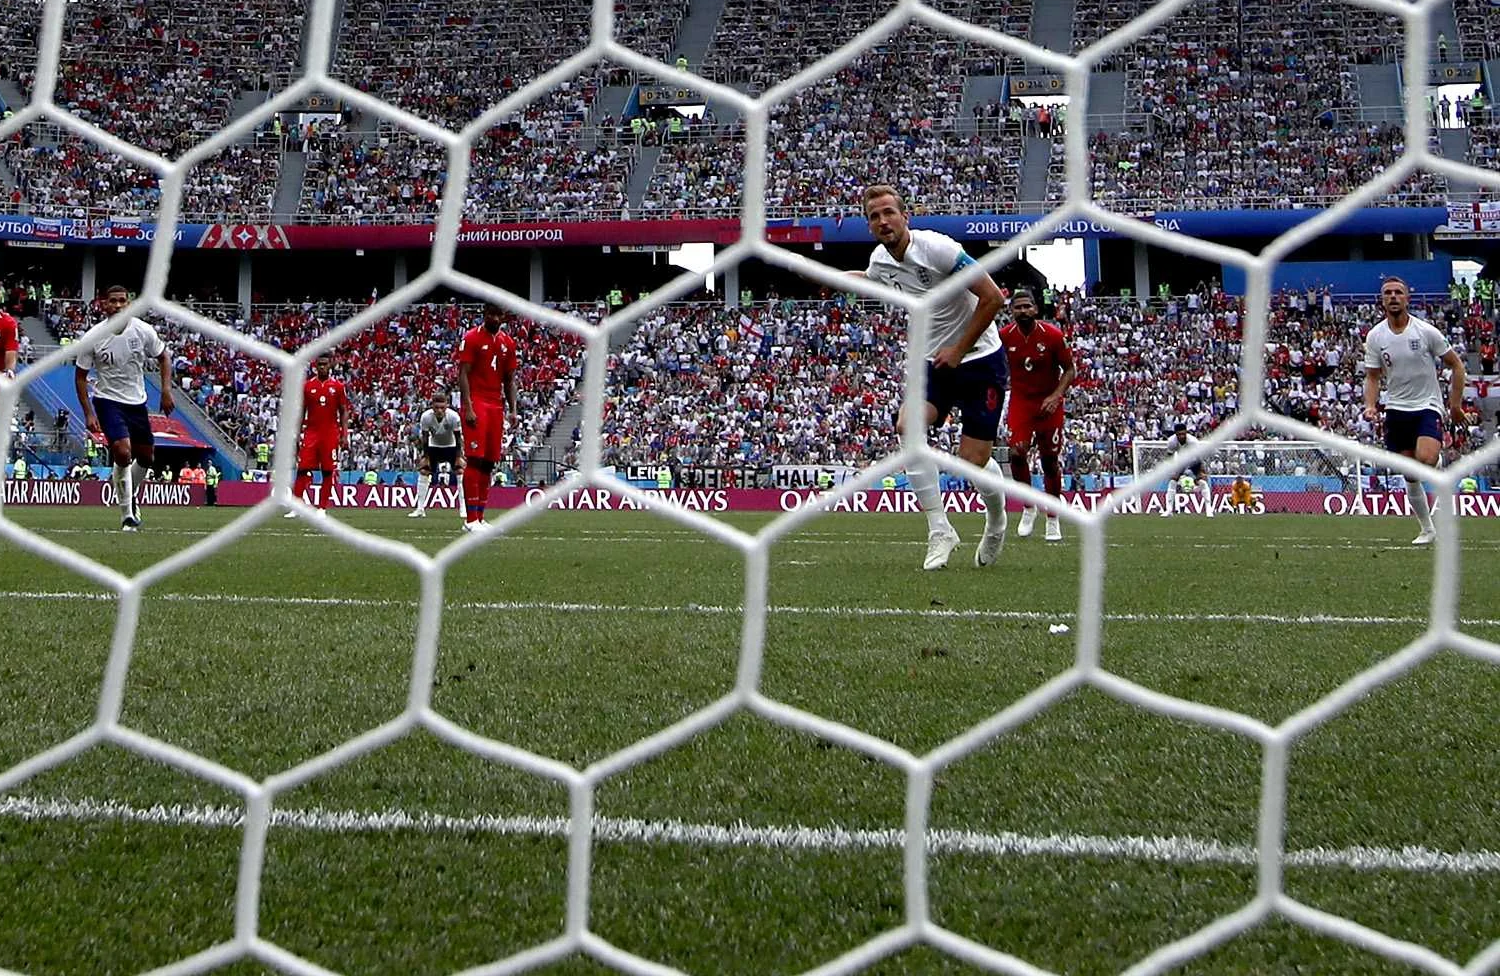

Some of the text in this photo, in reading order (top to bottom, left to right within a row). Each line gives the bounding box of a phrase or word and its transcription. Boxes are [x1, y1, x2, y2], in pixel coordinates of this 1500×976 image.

[965, 221, 999, 234] 2018
[1002, 221, 1032, 233] FIFA
[492, 229, 564, 241] НОВГОРОД
[102, 354, 115, 366] 21
[490, 355, 497, 371] 4
[1024, 357, 1033, 371] 6
[1052, 429, 1060, 444] 6
[29, 481, 81, 505] AIRWAYS
[141, 483, 191, 505] AIRWAYS
